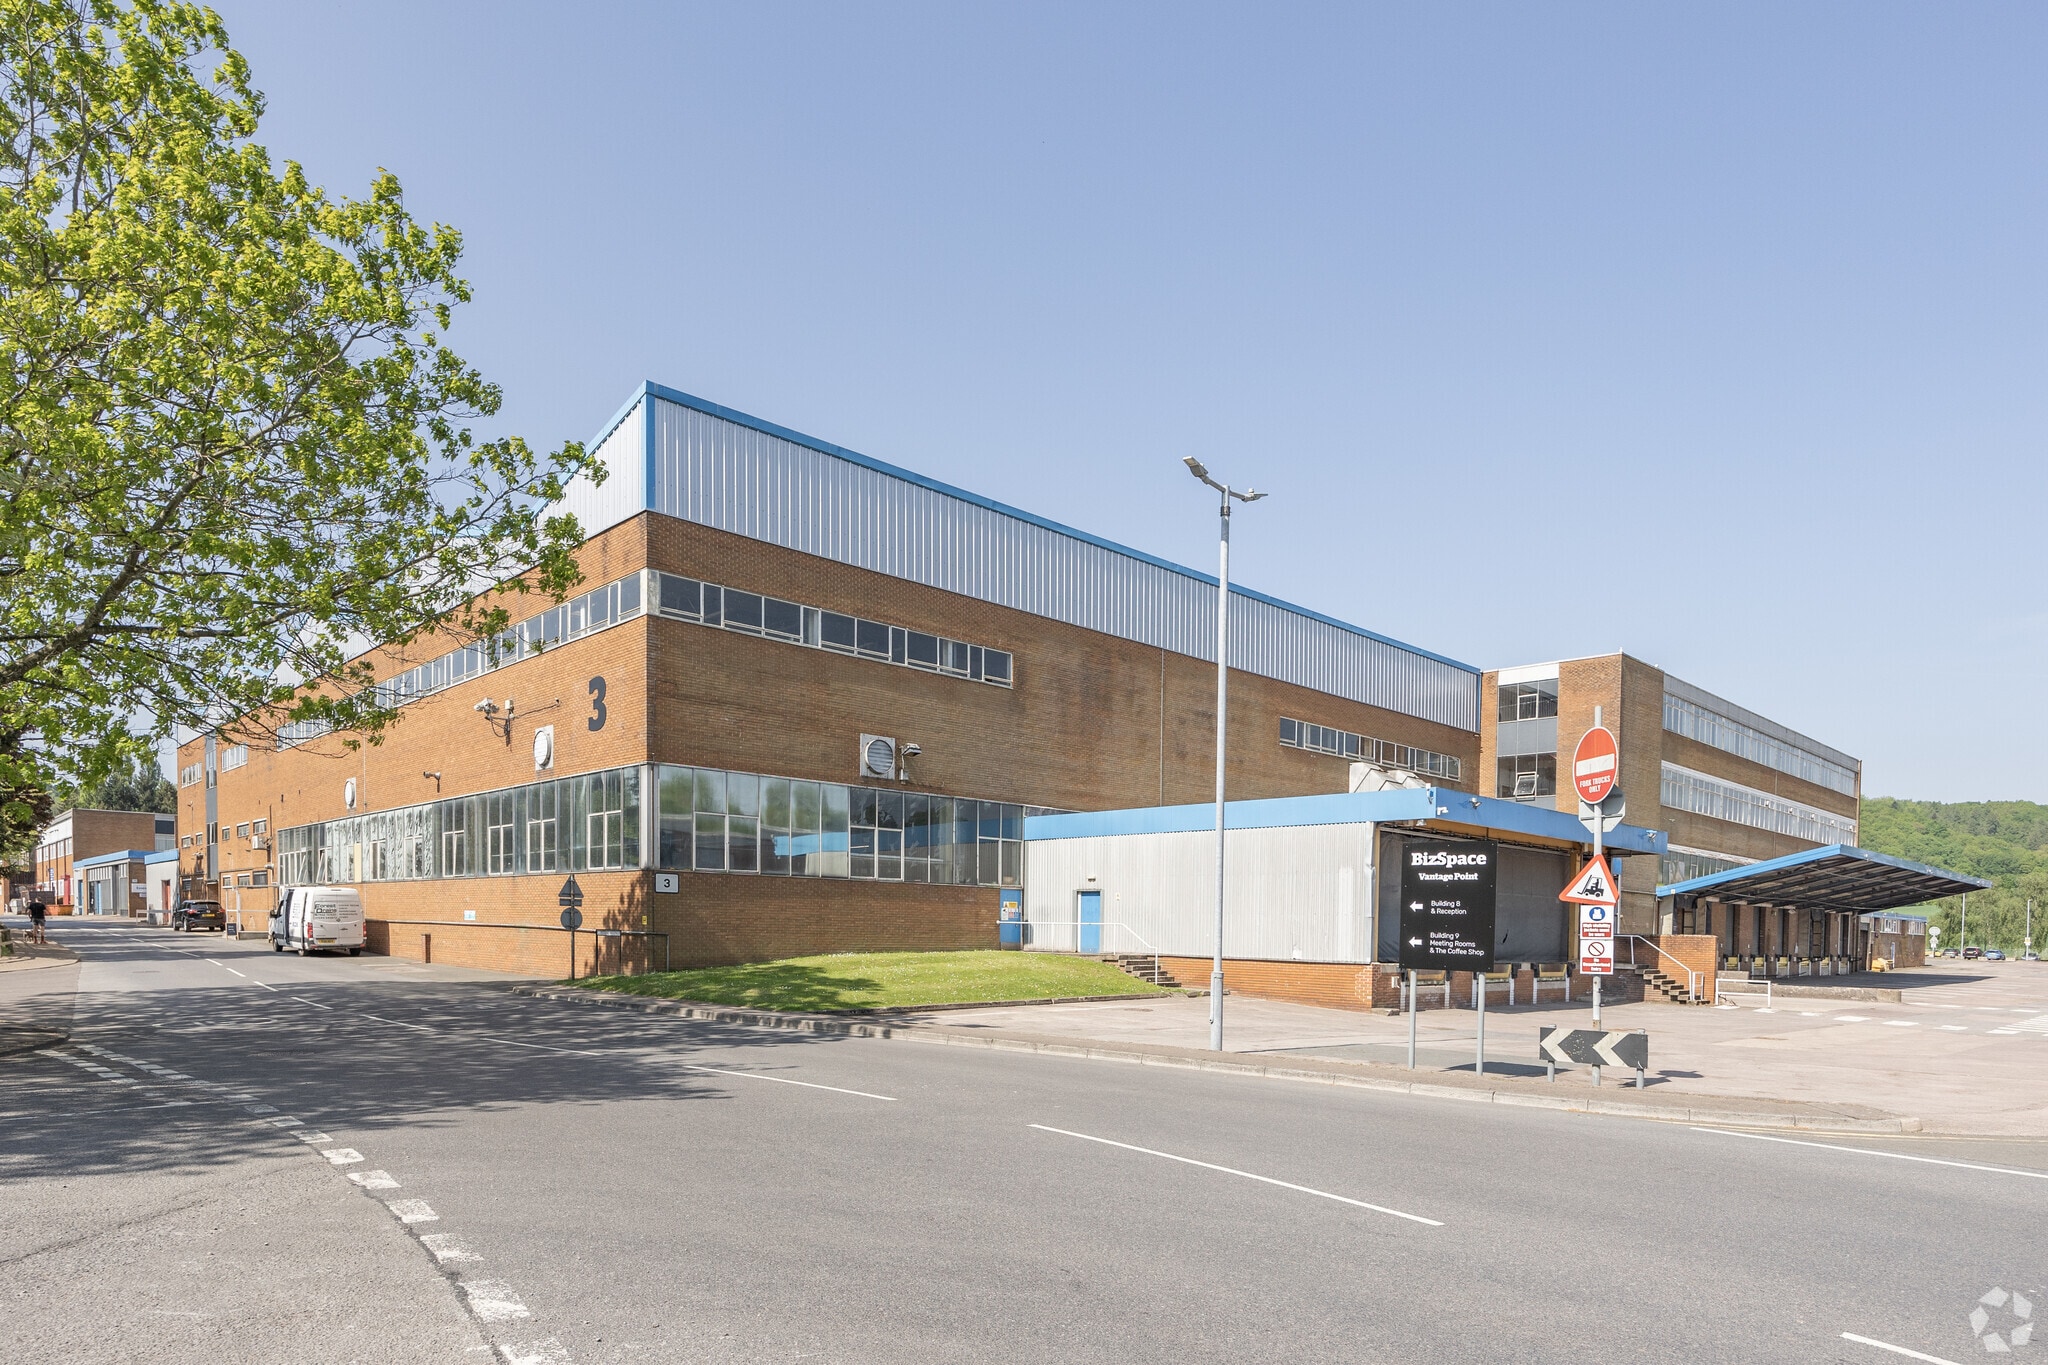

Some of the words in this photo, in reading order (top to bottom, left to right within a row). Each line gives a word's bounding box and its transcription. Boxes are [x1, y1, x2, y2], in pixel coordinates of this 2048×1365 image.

[588, 675, 607, 731] 3
[1592, 775, 1611, 786] TRUCKS
[1588, 784, 1601, 793] ONLY
[1411, 852, 1487, 868] BizSpace
[1418, 873, 1453, 882] Vantage
[1454, 872, 1479, 880] Point
[664, 879, 670, 888] 3
[1430, 900, 1455, 908] Building
[1430, 932, 1454, 940] Building
[1429, 940, 1454, 948] Meeting
[1468, 949, 1485, 957] Shop
